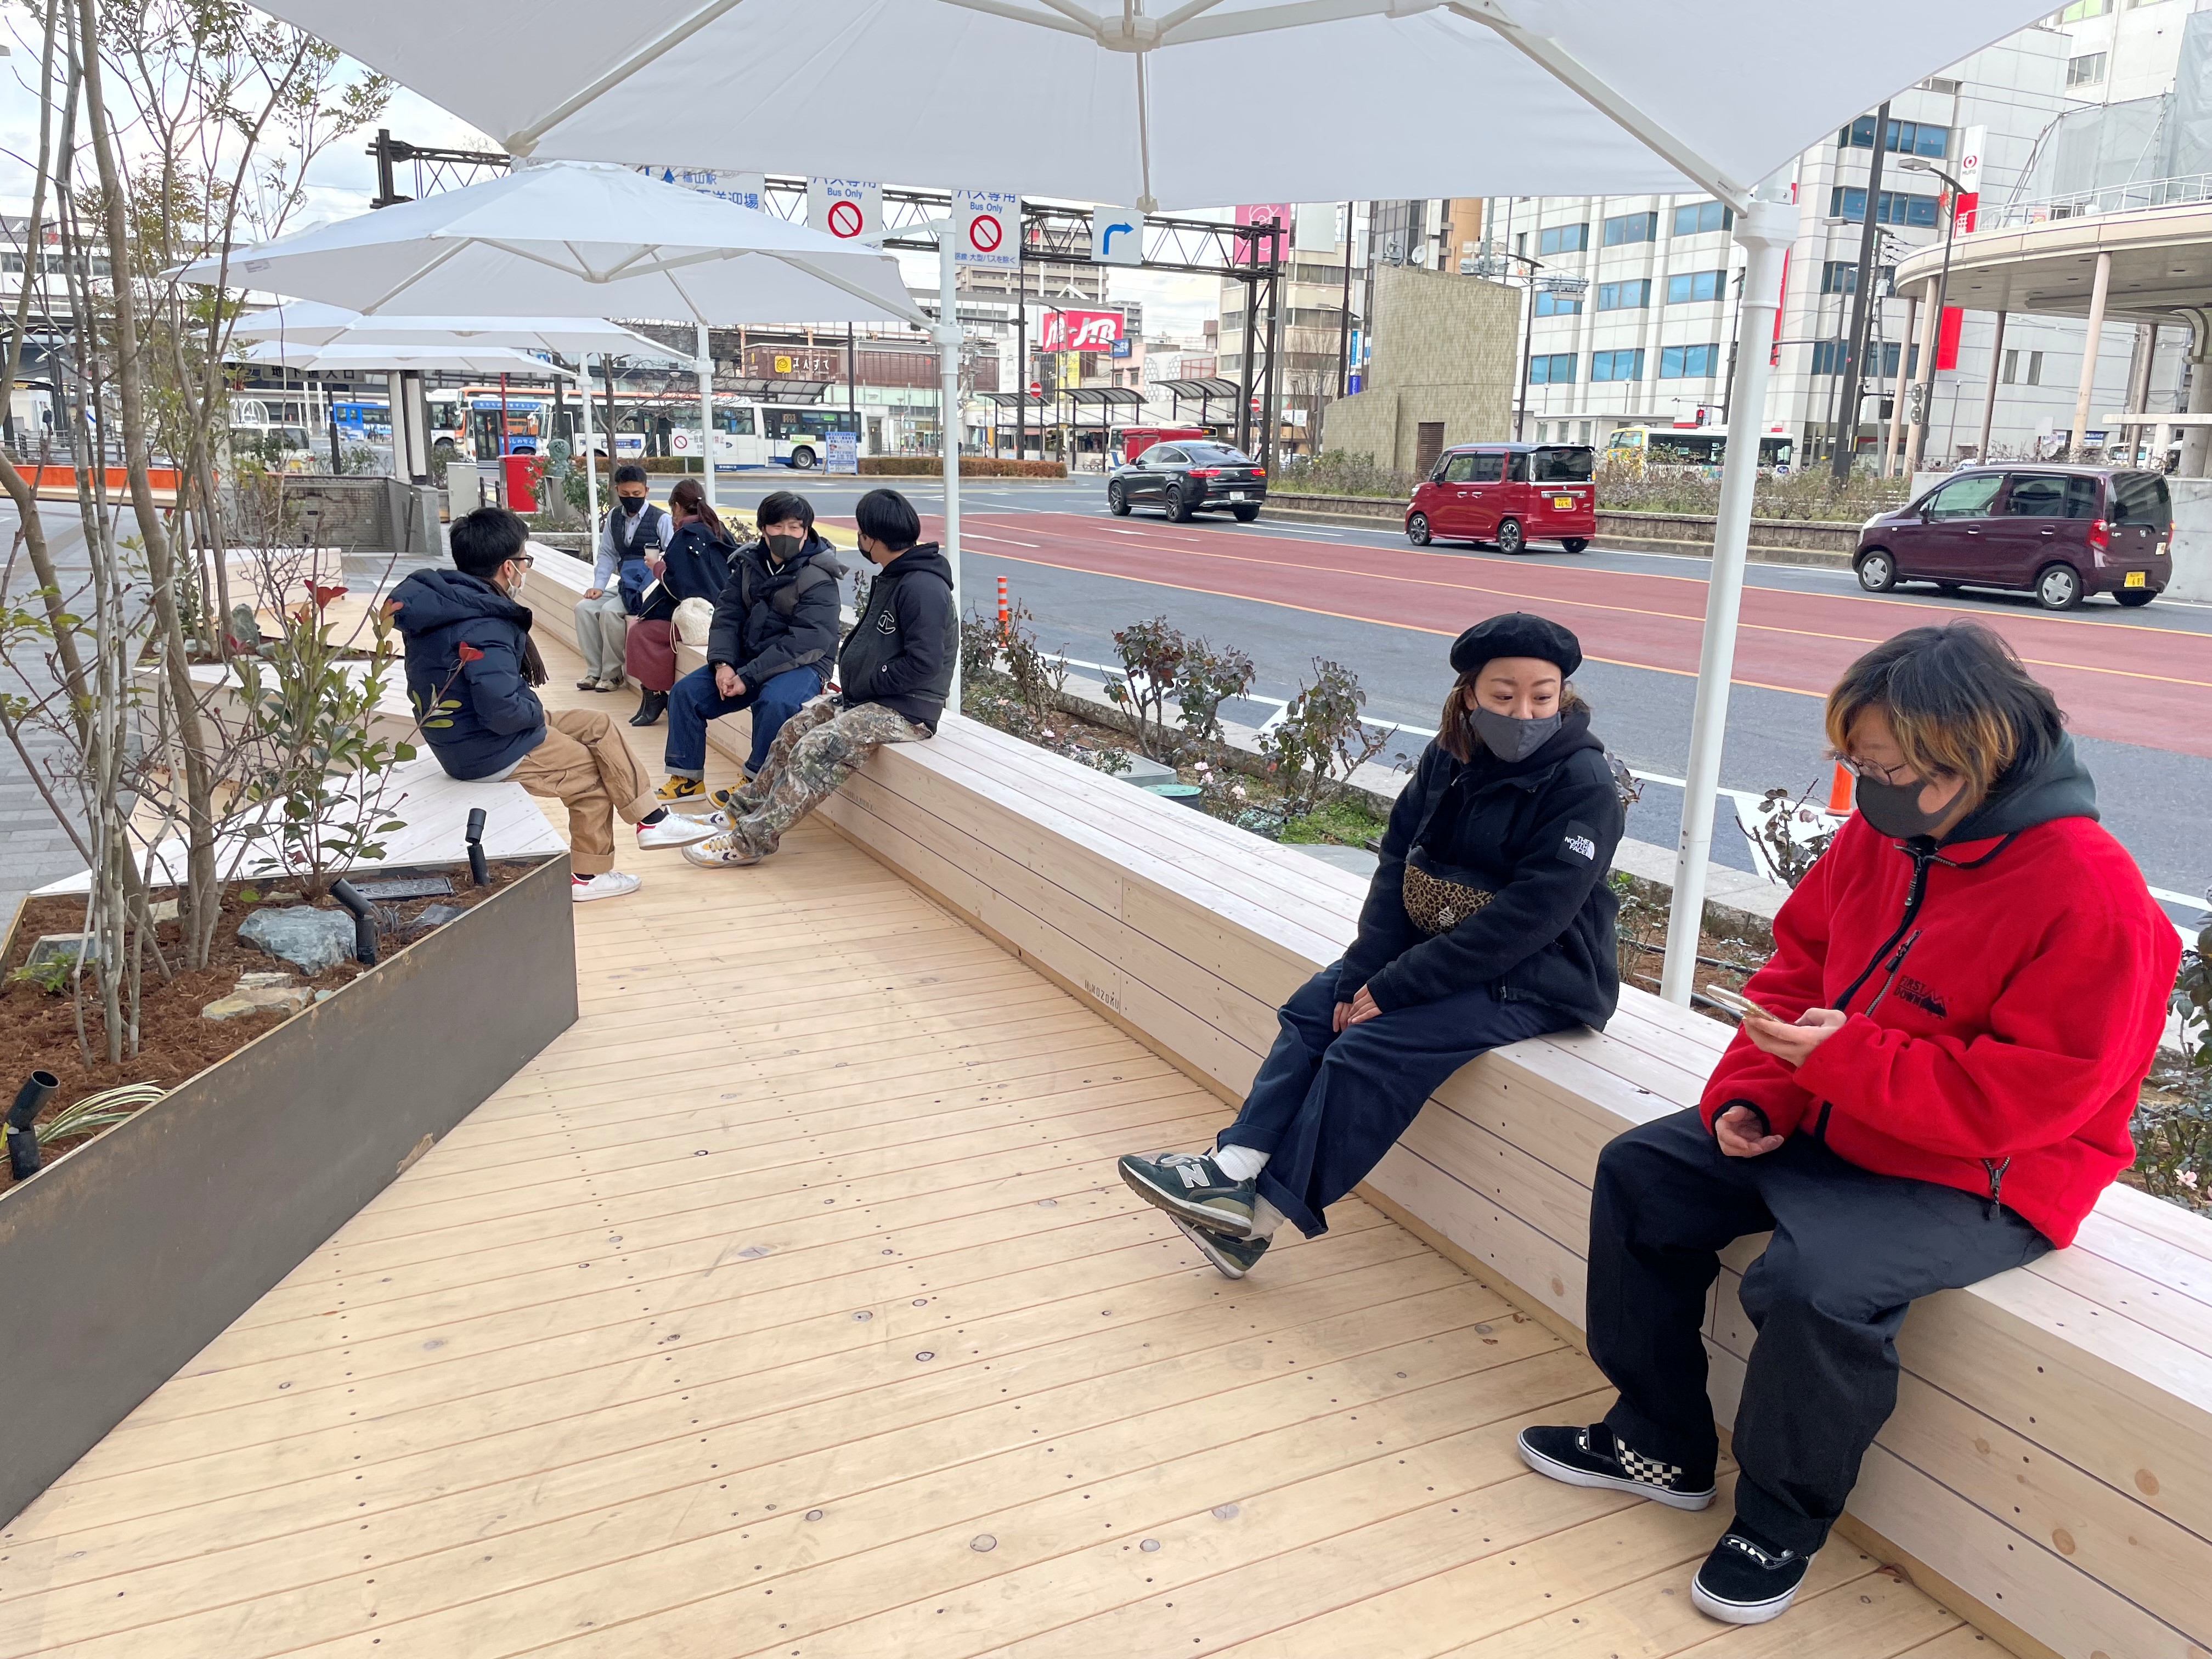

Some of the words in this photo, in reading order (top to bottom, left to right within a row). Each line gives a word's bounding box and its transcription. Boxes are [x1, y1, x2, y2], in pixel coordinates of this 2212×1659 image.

[827, 187, 842, 197] Bus
[845, 188, 863, 200] Only
[970, 202, 984, 210] Bus
[986, 203, 1003, 213] Only
[1073, 317, 1116, 348] JTB
[1564, 836, 1588, 851] NORTH
[1577, 834, 1590, 845] THE
[1569, 844, 1587, 855] FACE
